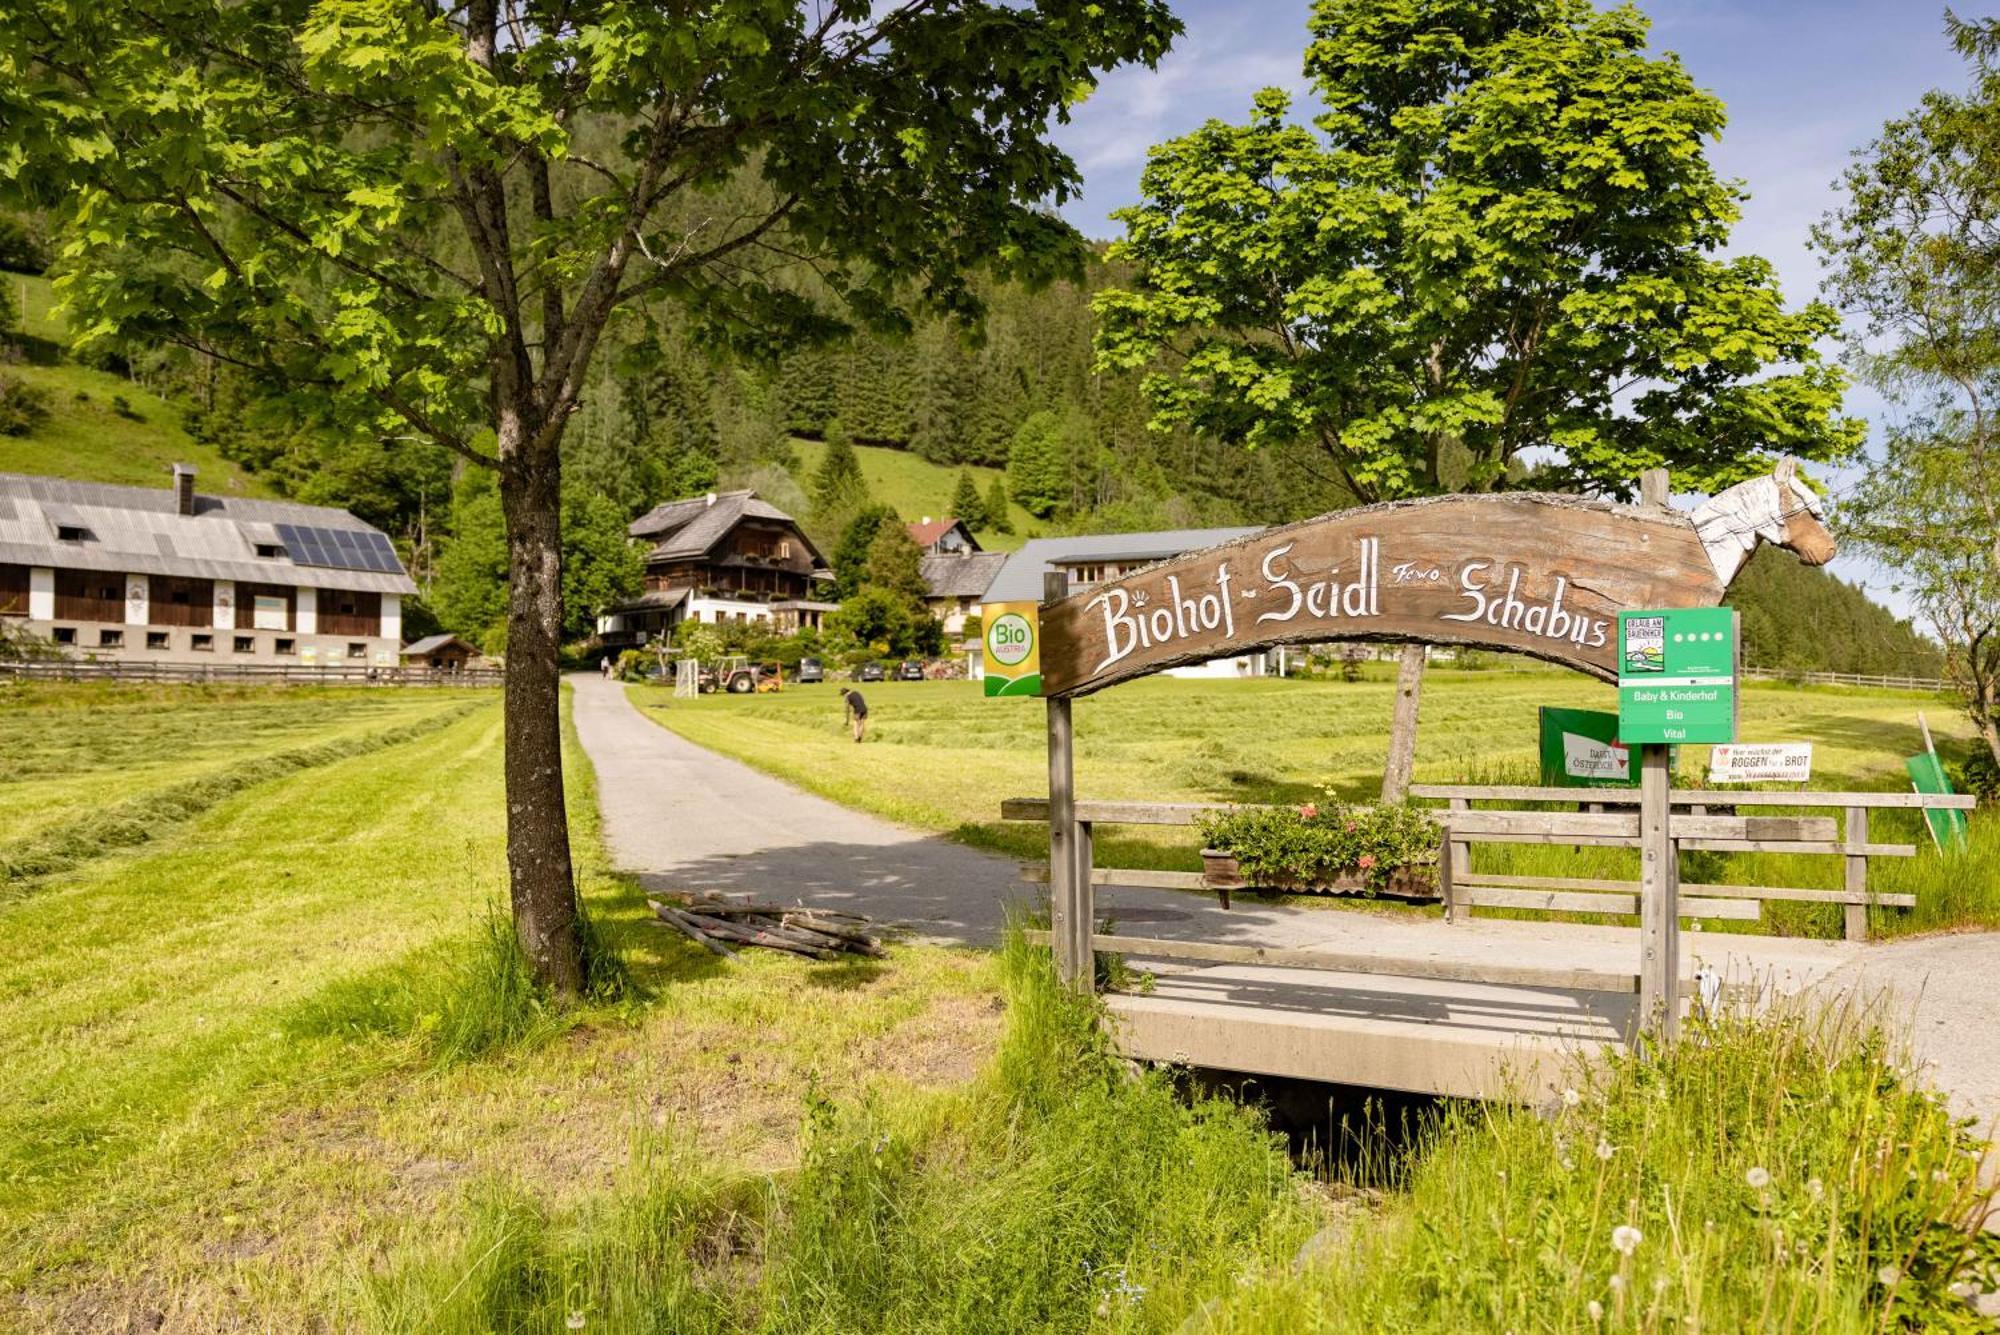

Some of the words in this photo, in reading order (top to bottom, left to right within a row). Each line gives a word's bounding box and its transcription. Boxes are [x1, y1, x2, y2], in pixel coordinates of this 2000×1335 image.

[1084, 562, 1234, 675] Biohof
[1256, 542, 1380, 625] Seidl
[1440, 563, 1610, 648] Schabus
[996, 623, 1025, 645] Bio
[1634, 691, 1657, 704] Baby
[1660, 691, 1668, 701] &
[1670, 691, 1717, 701] Kinderhof
[1666, 710, 1683, 720] Bio
[1664, 728, 1686, 739] Vital
[1731, 756, 1768, 768] ROGGEN
[1785, 755, 1808, 767] BROT
